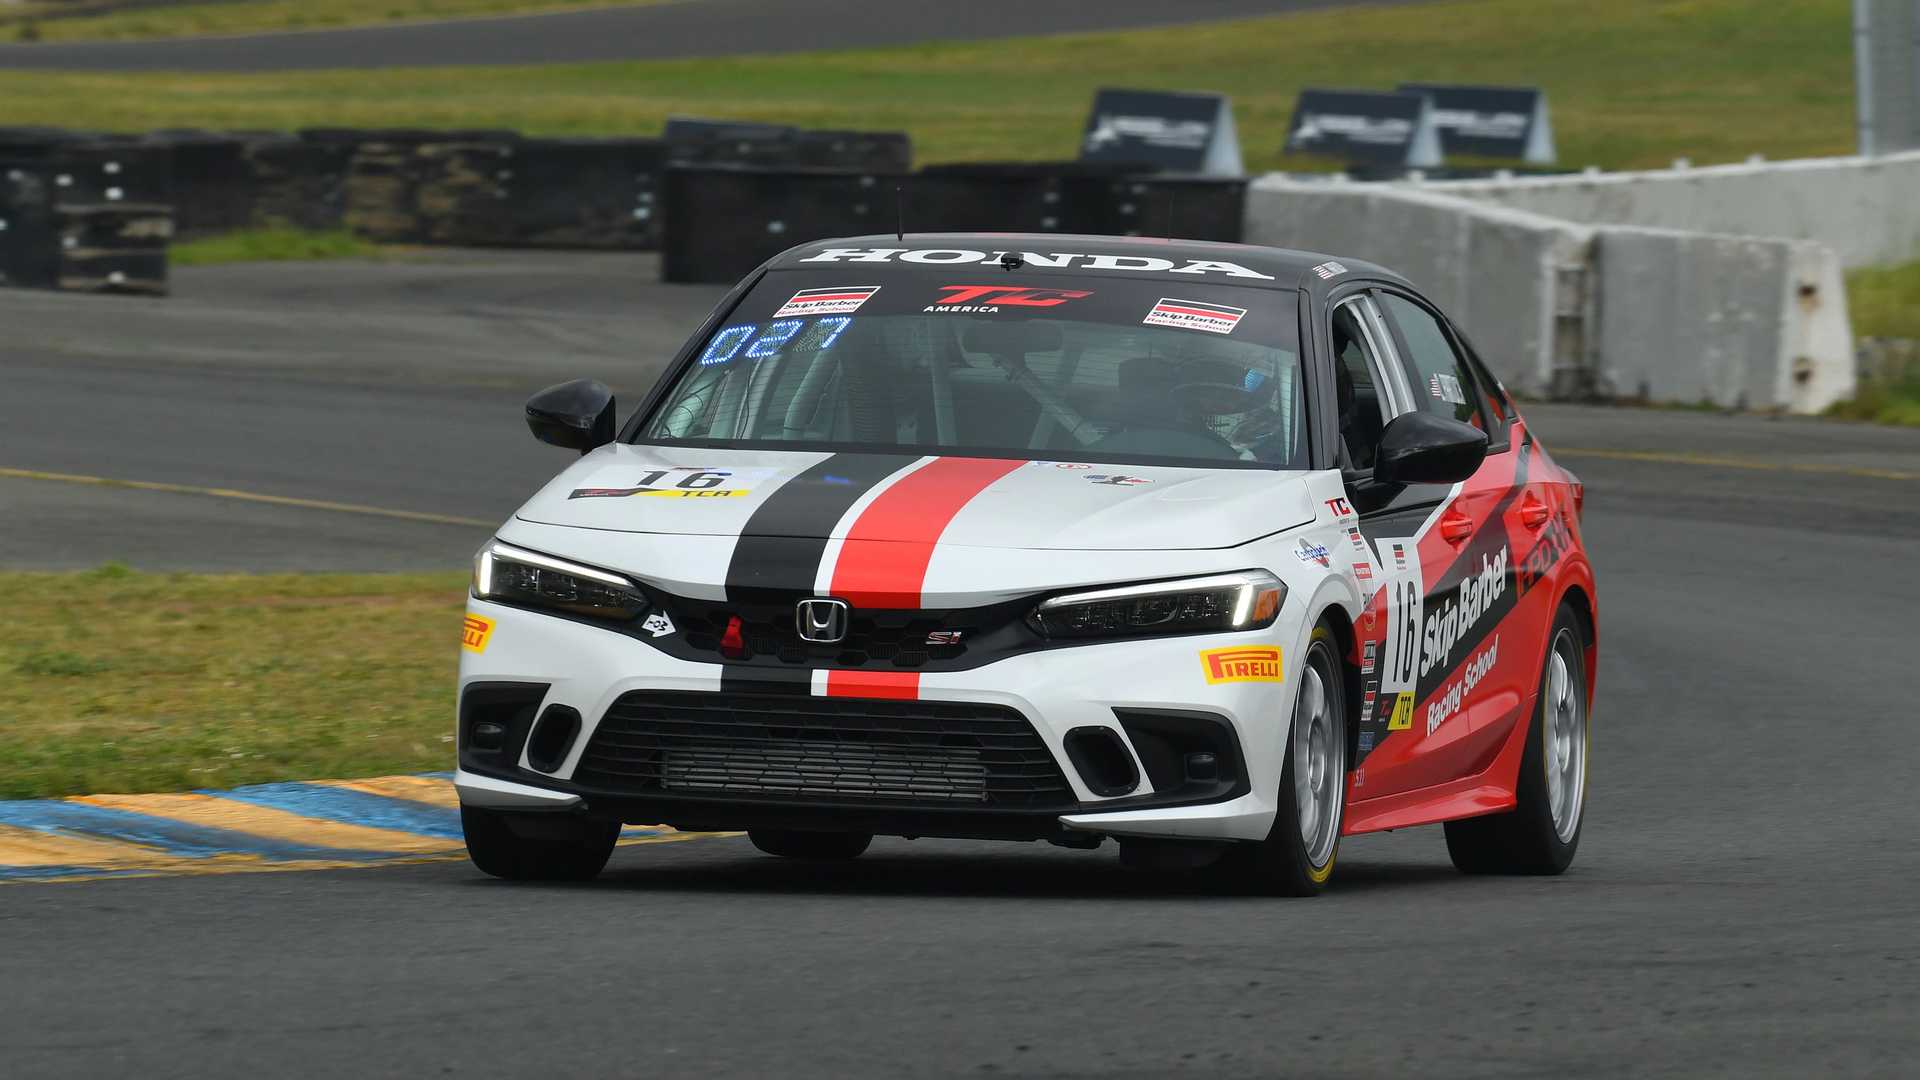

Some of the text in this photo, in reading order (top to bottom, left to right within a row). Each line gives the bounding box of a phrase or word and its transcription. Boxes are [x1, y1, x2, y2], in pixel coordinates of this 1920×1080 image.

[800, 248, 1275, 280] HONDA
[814, 300, 862, 308] Barber
[923, 305, 999, 313] AMERICA
[1146, 317, 1230, 332] Racing School
[1151, 311, 1234, 327] Skip Barber
[701, 316, 851, 366] 027
[637, 470, 732, 489] 16
[1324, 497, 1351, 517] TC
[1420, 544, 1507, 678] Skip Barber
[1392, 580, 1417, 684] 16
[1207, 650, 1279, 680] PIRELLI
[1426, 633, 1499, 737] Racing School
